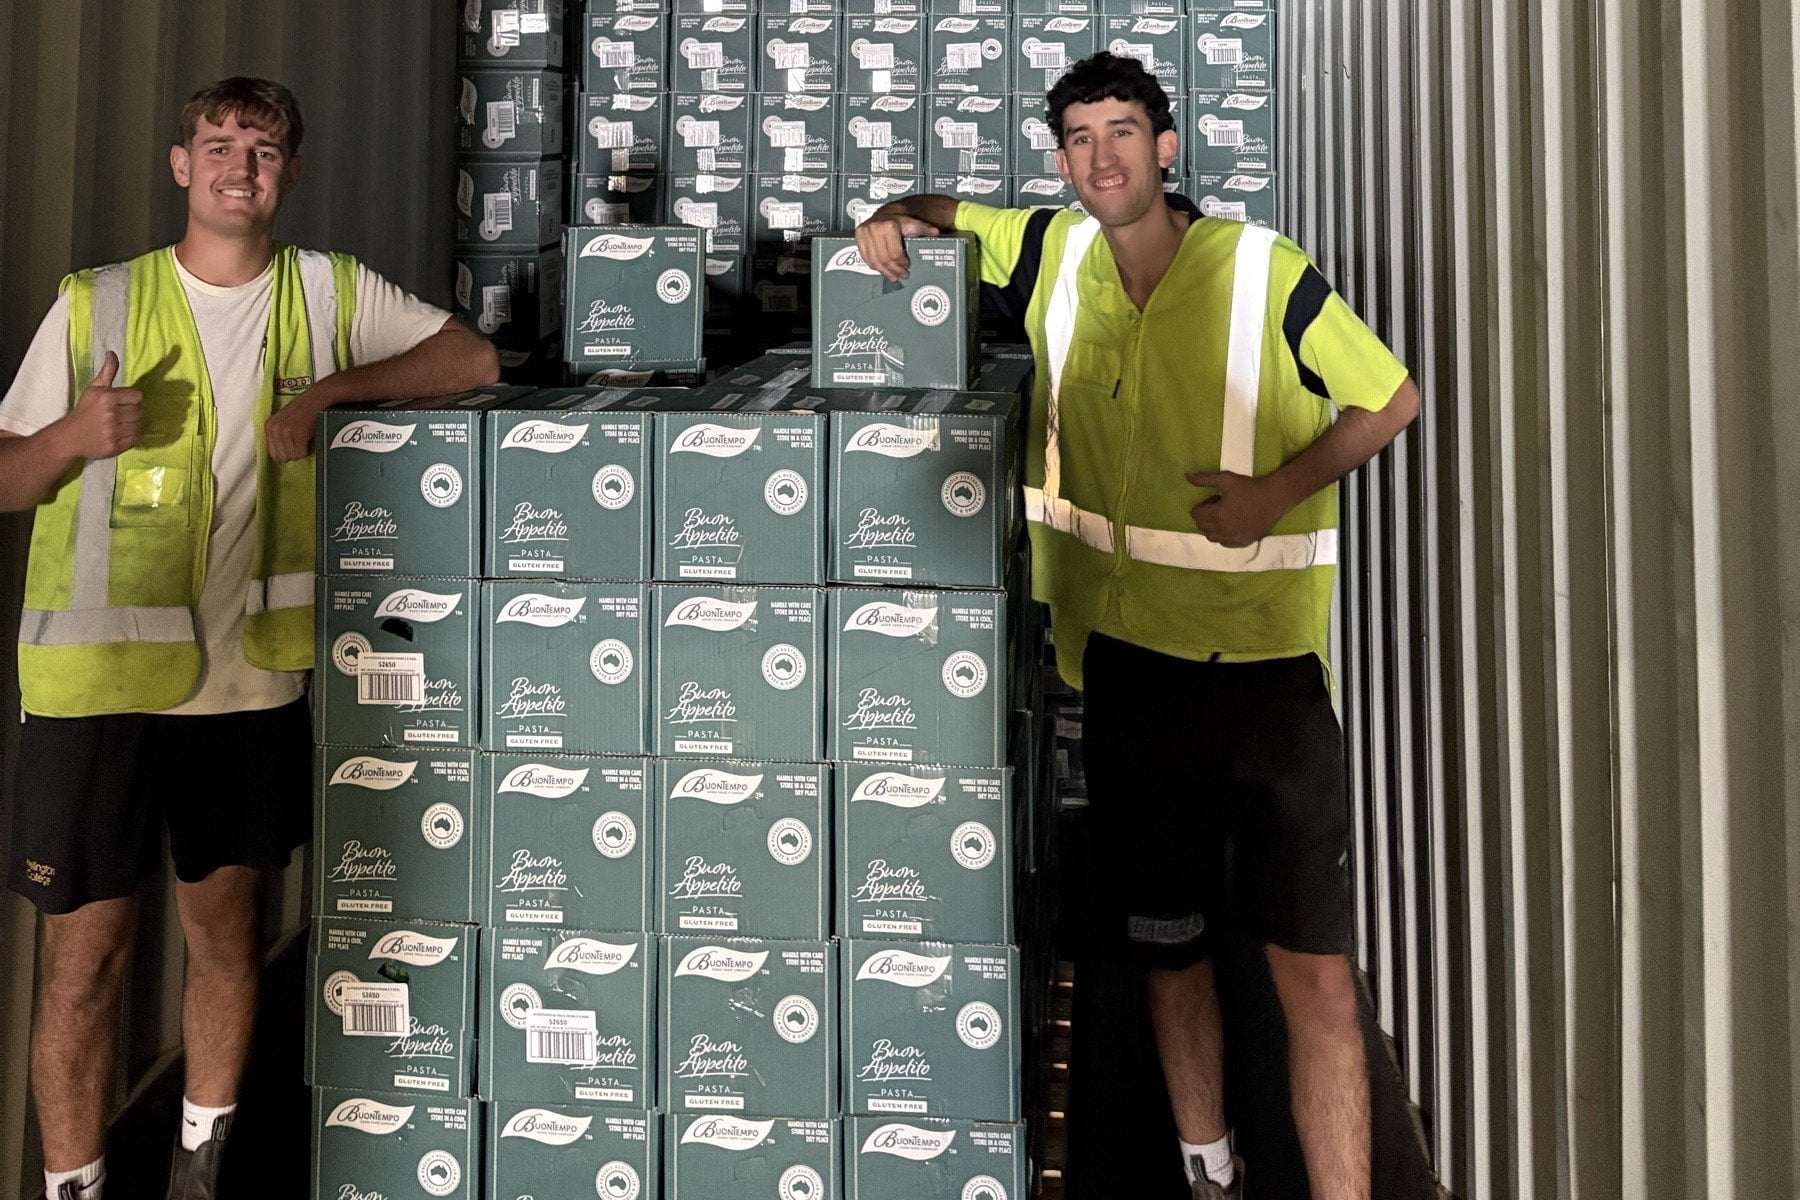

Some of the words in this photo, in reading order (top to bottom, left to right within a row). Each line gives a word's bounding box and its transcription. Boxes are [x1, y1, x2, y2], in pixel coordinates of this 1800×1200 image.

[590, 237, 641, 251] BUONTEMPO
[590, 299, 630, 315] Buon
[579, 314, 634, 332] Appetito
[838, 320, 883, 338] Buon
[825, 336, 888, 357] Appetito
[845, 362, 872, 370] PASTA
[341, 424, 403, 441] BUONTEMPO
[512, 424, 574, 441] BUONTEMPO
[681, 428, 745, 446] BUONTEMPO
[856, 427, 922, 446] BUONTEMPO
[344, 501, 394, 520] Buon
[513, 503, 563, 523] Buon
[684, 507, 736, 528] Buon
[859, 507, 911, 528] Buon
[330, 519, 398, 541] Appetito
[499, 521, 568, 543] Appetito
[669, 526, 740, 549] Appetito
[844, 526, 916, 549] Appetito
[352, 547, 382, 556] PASTA
[521, 549, 551, 558] PASTA
[692, 555, 723, 564] PASTA
[867, 555, 898, 564] PASTA
[384, 593, 448, 611] BUONTEMPO
[507, 597, 571, 616] BUONTEMPO
[677, 601, 741, 619] BUONTEMPO
[856, 606, 922, 625] BUONTEMPO
[510, 677, 561, 697] Buon
[680, 681, 732, 702] Buon
[496, 695, 566, 718] Appetito
[859, 688, 911, 709] Buon
[665, 700, 736, 723] Appetito
[844, 707, 916, 730] Appetito
[416, 719, 446, 728] PASTA
[518, 724, 549, 733] PASTA
[688, 729, 719, 738] PASTA
[867, 737, 898, 745] PASTA
[341, 761, 403, 778] BUONTEMPO
[510, 768, 574, 786] BUONTEMPO
[682, 773, 748, 792] BUONTEMPO
[863, 776, 931, 796] BUONTEMPO
[341, 841, 392, 861] Buon
[511, 850, 563, 871] Buon
[327, 859, 397, 882] Appetito
[684, 856, 737, 877] Buon
[866, 859, 920, 880] Buon
[496, 869, 568, 892] Appetito
[669, 875, 742, 899] Appetito
[349, 888, 380, 897] PASTA
[851, 878, 926, 903] Appetito
[519, 898, 550, 907] PASTA
[692, 906, 724, 914] PASTA
[875, 910, 908, 919] PASTA
[380, 935, 444, 953] BUONTEMPO
[556, 943, 622, 962] BUONTEMPO
[686, 950, 754, 970] BUONTEMPO
[868, 954, 936, 974] BUONTEMPO
[384, 1035, 455, 1059] Appetito
[689, 1034, 743, 1055] Buon
[872, 1039, 925, 1060] Buon
[406, 1066, 437, 1074] PASTA
[674, 1053, 748, 1078] Appetito
[857, 1058, 930, 1082] Appetito
[588, 1077, 619, 1085] PASTA
[698, 1085, 731, 1094] PASTA
[880, 1088, 912, 1098] PASTA
[336, 1104, 400, 1122] BUONTEMPO
[513, 1114, 577, 1132] BUONTEMPO
[692, 1118, 760, 1138] BUONTEMPO
[873, 1128, 941, 1147] BUONTEMPO
